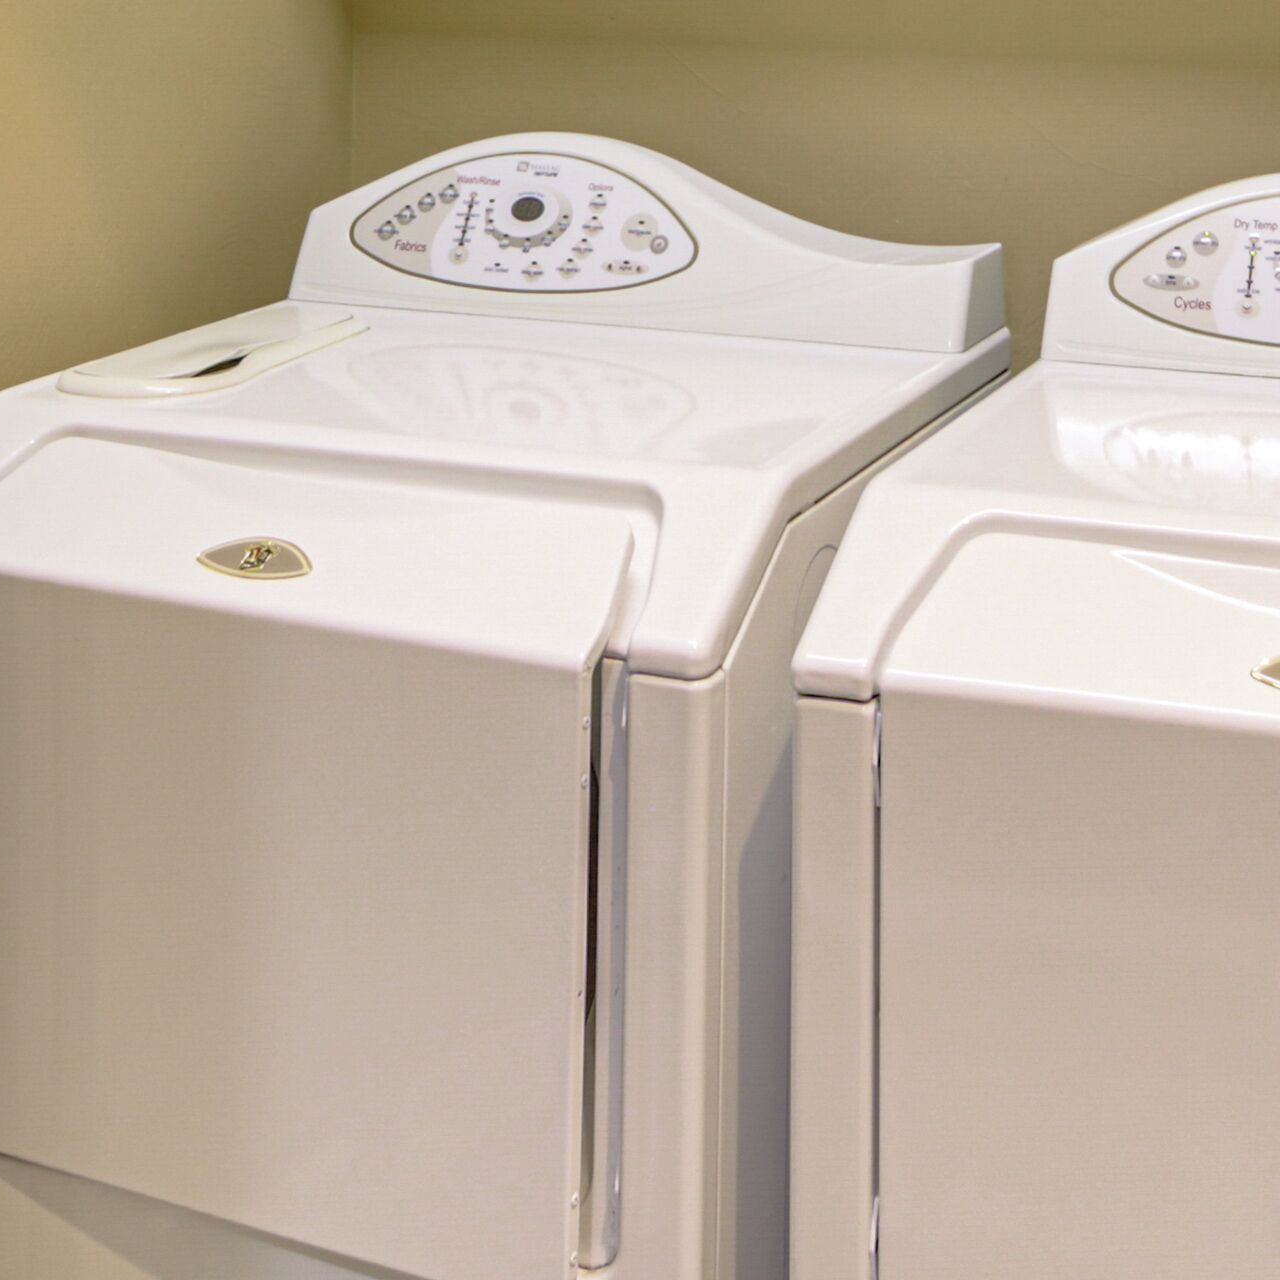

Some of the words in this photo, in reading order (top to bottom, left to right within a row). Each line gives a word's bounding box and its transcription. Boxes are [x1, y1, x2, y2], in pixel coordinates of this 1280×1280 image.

[457, 175, 501, 187] Wash/Rinse
[1233, 218, 1250, 231] Dry
[1253, 220, 1279, 231] Temp
[394, 240, 427, 253] Fabrics
[1174, 296, 1212, 311] Cycles
